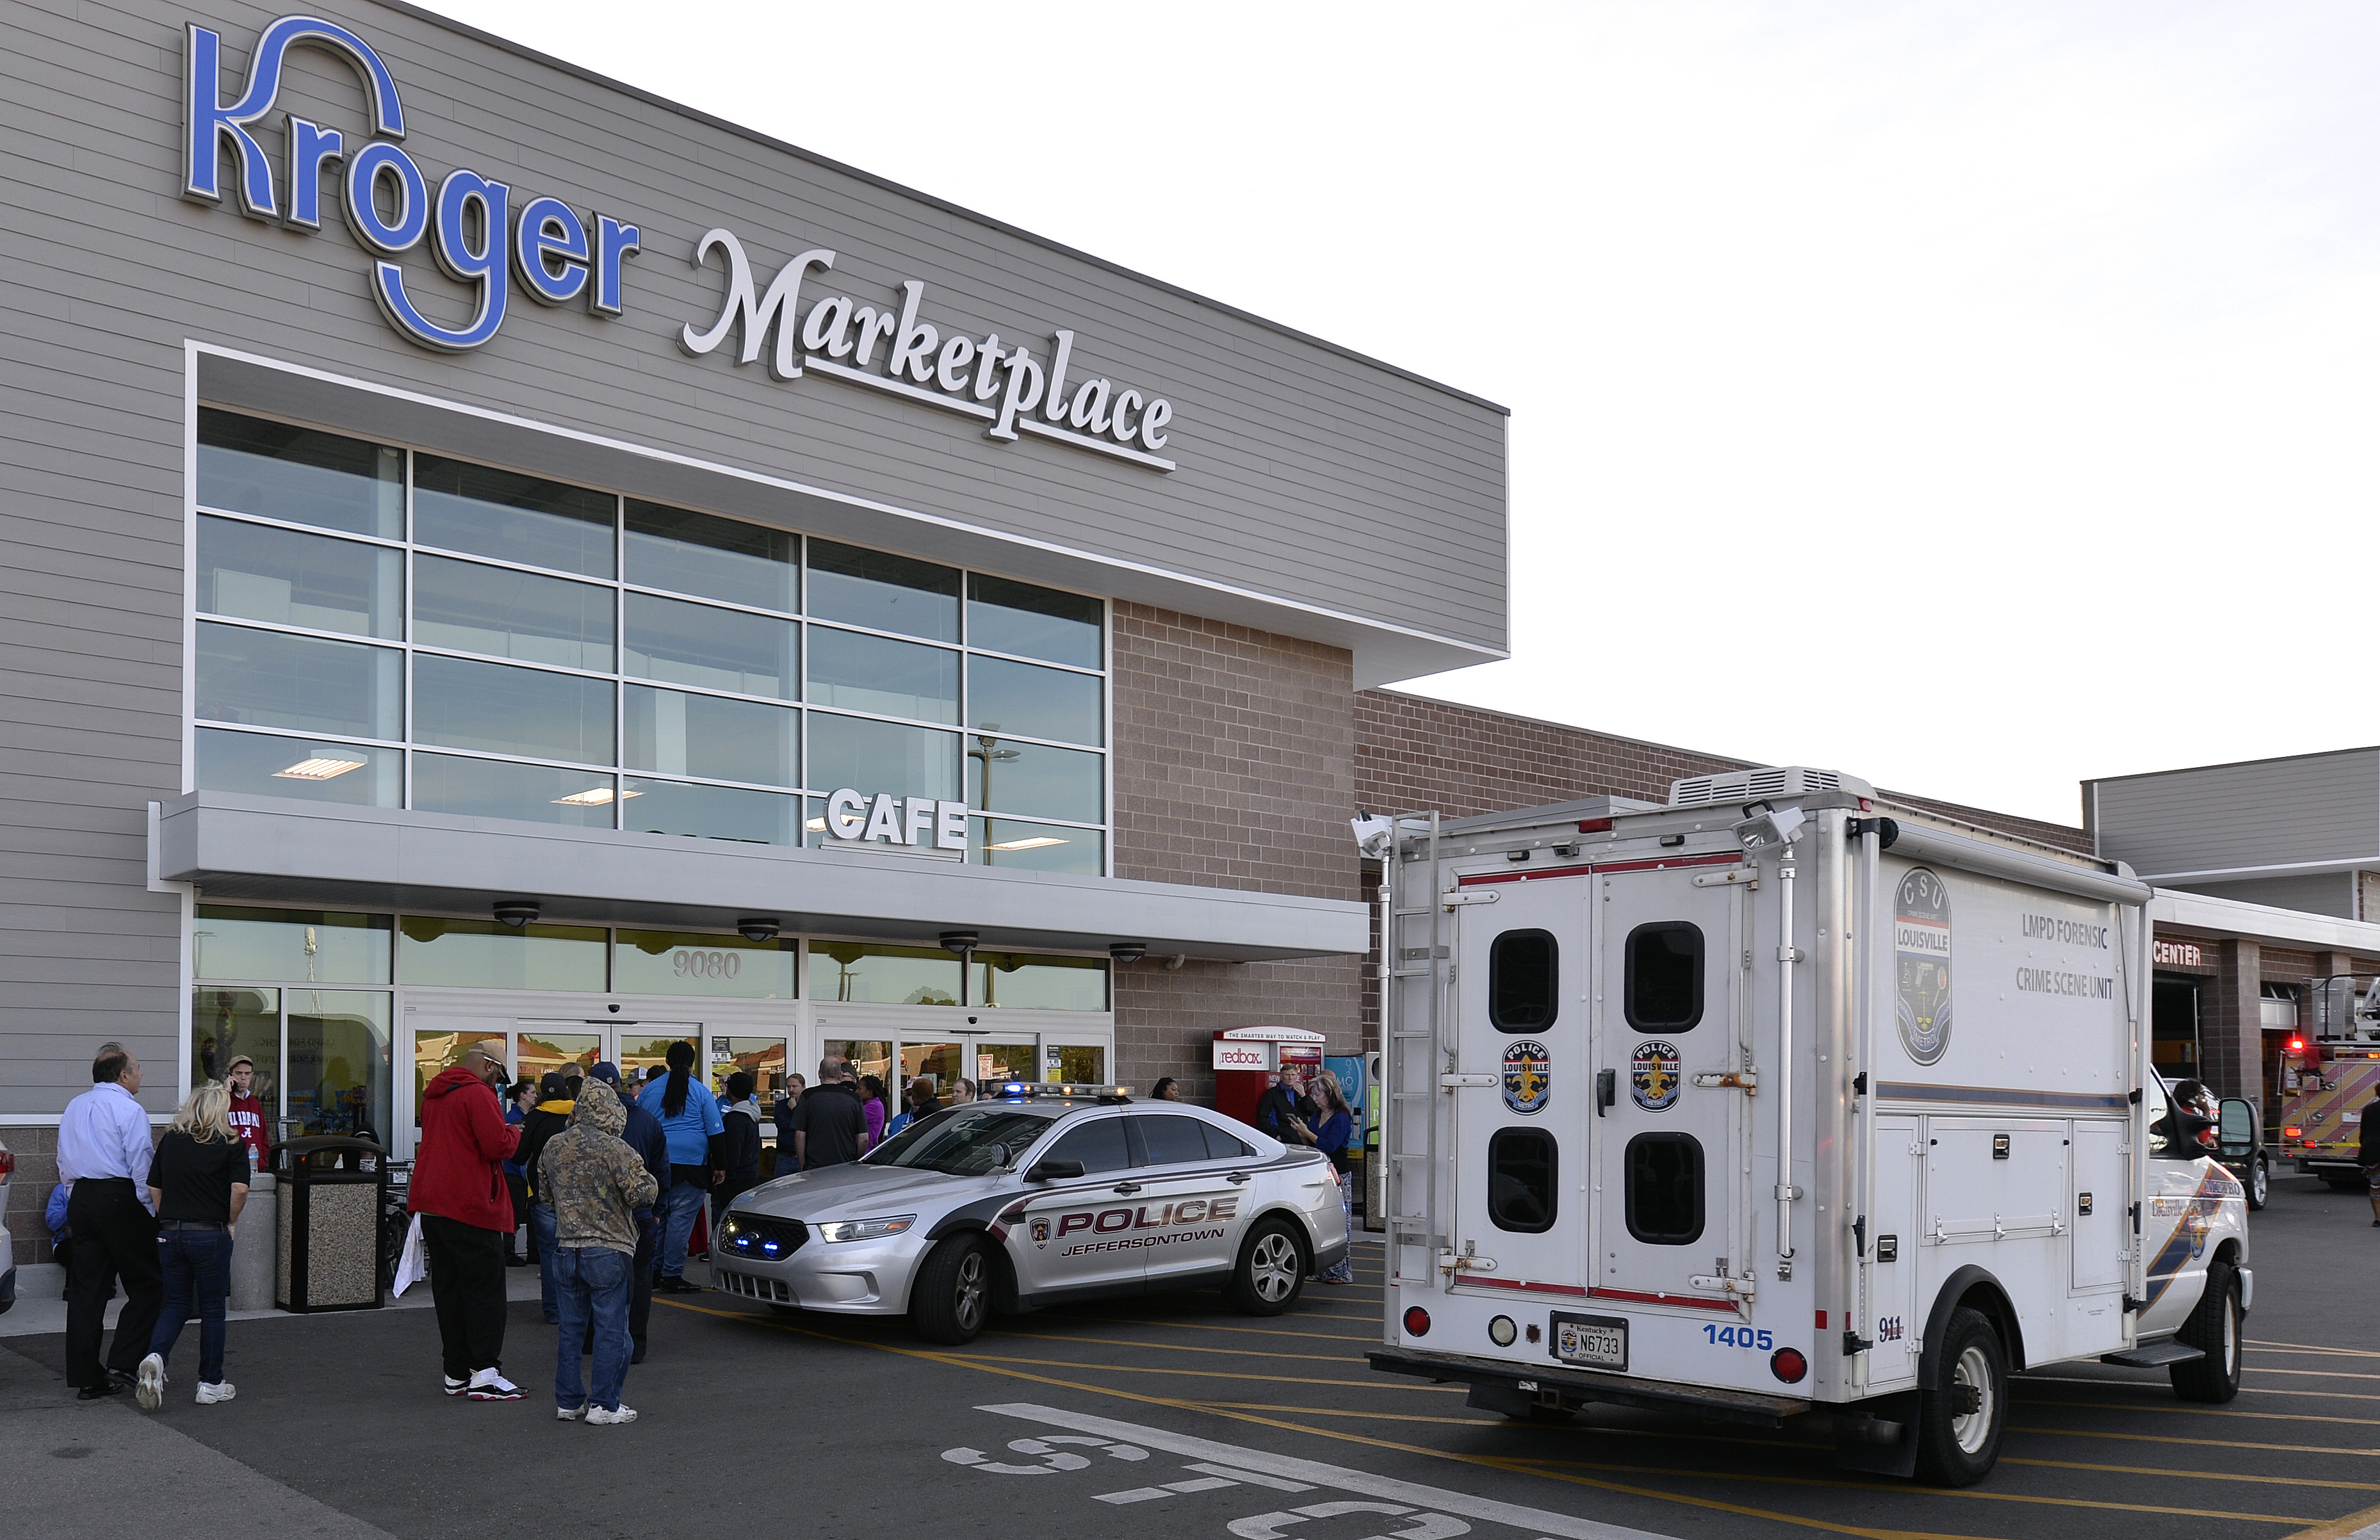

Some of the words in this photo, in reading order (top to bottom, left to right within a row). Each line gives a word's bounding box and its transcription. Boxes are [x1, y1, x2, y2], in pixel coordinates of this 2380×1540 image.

[180, 13, 640, 354] Kroger
[676, 228, 1174, 452] Marketplace
[823, 787, 968, 850] CAFE
[1905, 875, 1943, 909] CSU
[1898, 928, 1948, 952] LOUISVILLE
[2023, 914, 2055, 941] LMPD
[2057, 920, 2107, 950] FORENSIC
[674, 950, 741, 979] 9080
[2153, 940, 2201, 967] CENTER
[2016, 967, 2051, 994] CRIME
[2054, 971, 2087, 997] SCENE
[2090, 976, 2114, 1000] UNIT
[1507, 1044, 1545, 1060] POLICE
[1636, 1044, 1676, 1059] POLICE
[1915, 1032, 1935, 1047] METRO
[1054, 1196, 1240, 1240] POLICE
[1061, 1228, 1225, 1258] JEFFERSONTOWN
[1576, 1325, 1607, 1335] Kentucky
[1703, 1324, 1773, 1350] 1405
[1879, 1315, 1902, 1343] 911
[1578, 1353, 1604, 1361] OFFICIAL
[1581, 1334, 1618, 1354] N6733
